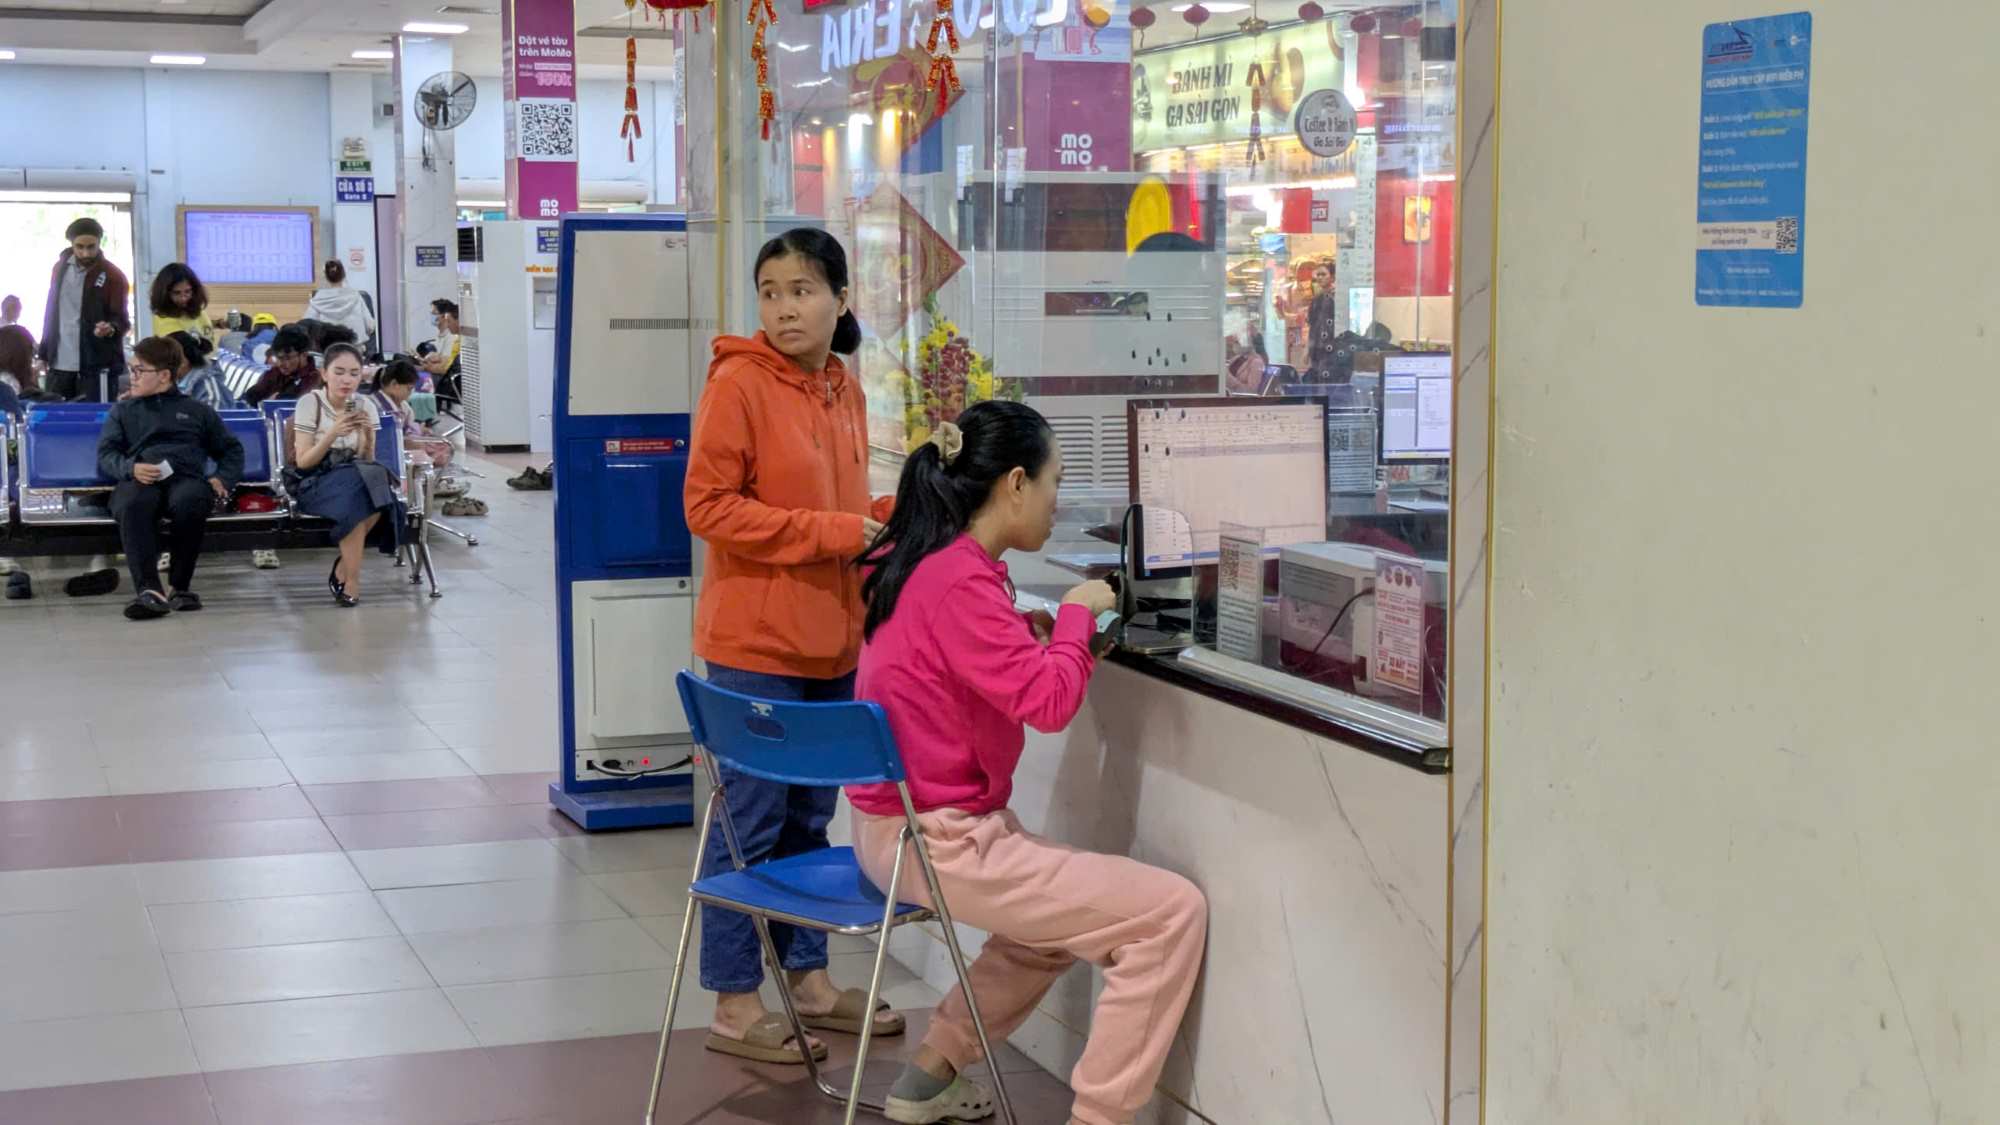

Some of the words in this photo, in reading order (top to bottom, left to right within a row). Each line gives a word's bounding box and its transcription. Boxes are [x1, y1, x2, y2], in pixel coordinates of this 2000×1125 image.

[519, 35, 537, 47] Đặt
[519, 47, 539, 56] trên
[541, 48, 572, 57] MoMo
[1172, 62, 1212, 94] BÁNH
[1166, 101, 1184, 128] GA
[1185, 93, 1208, 124] SÀI
[1211, 91, 1241, 122] GÒN
